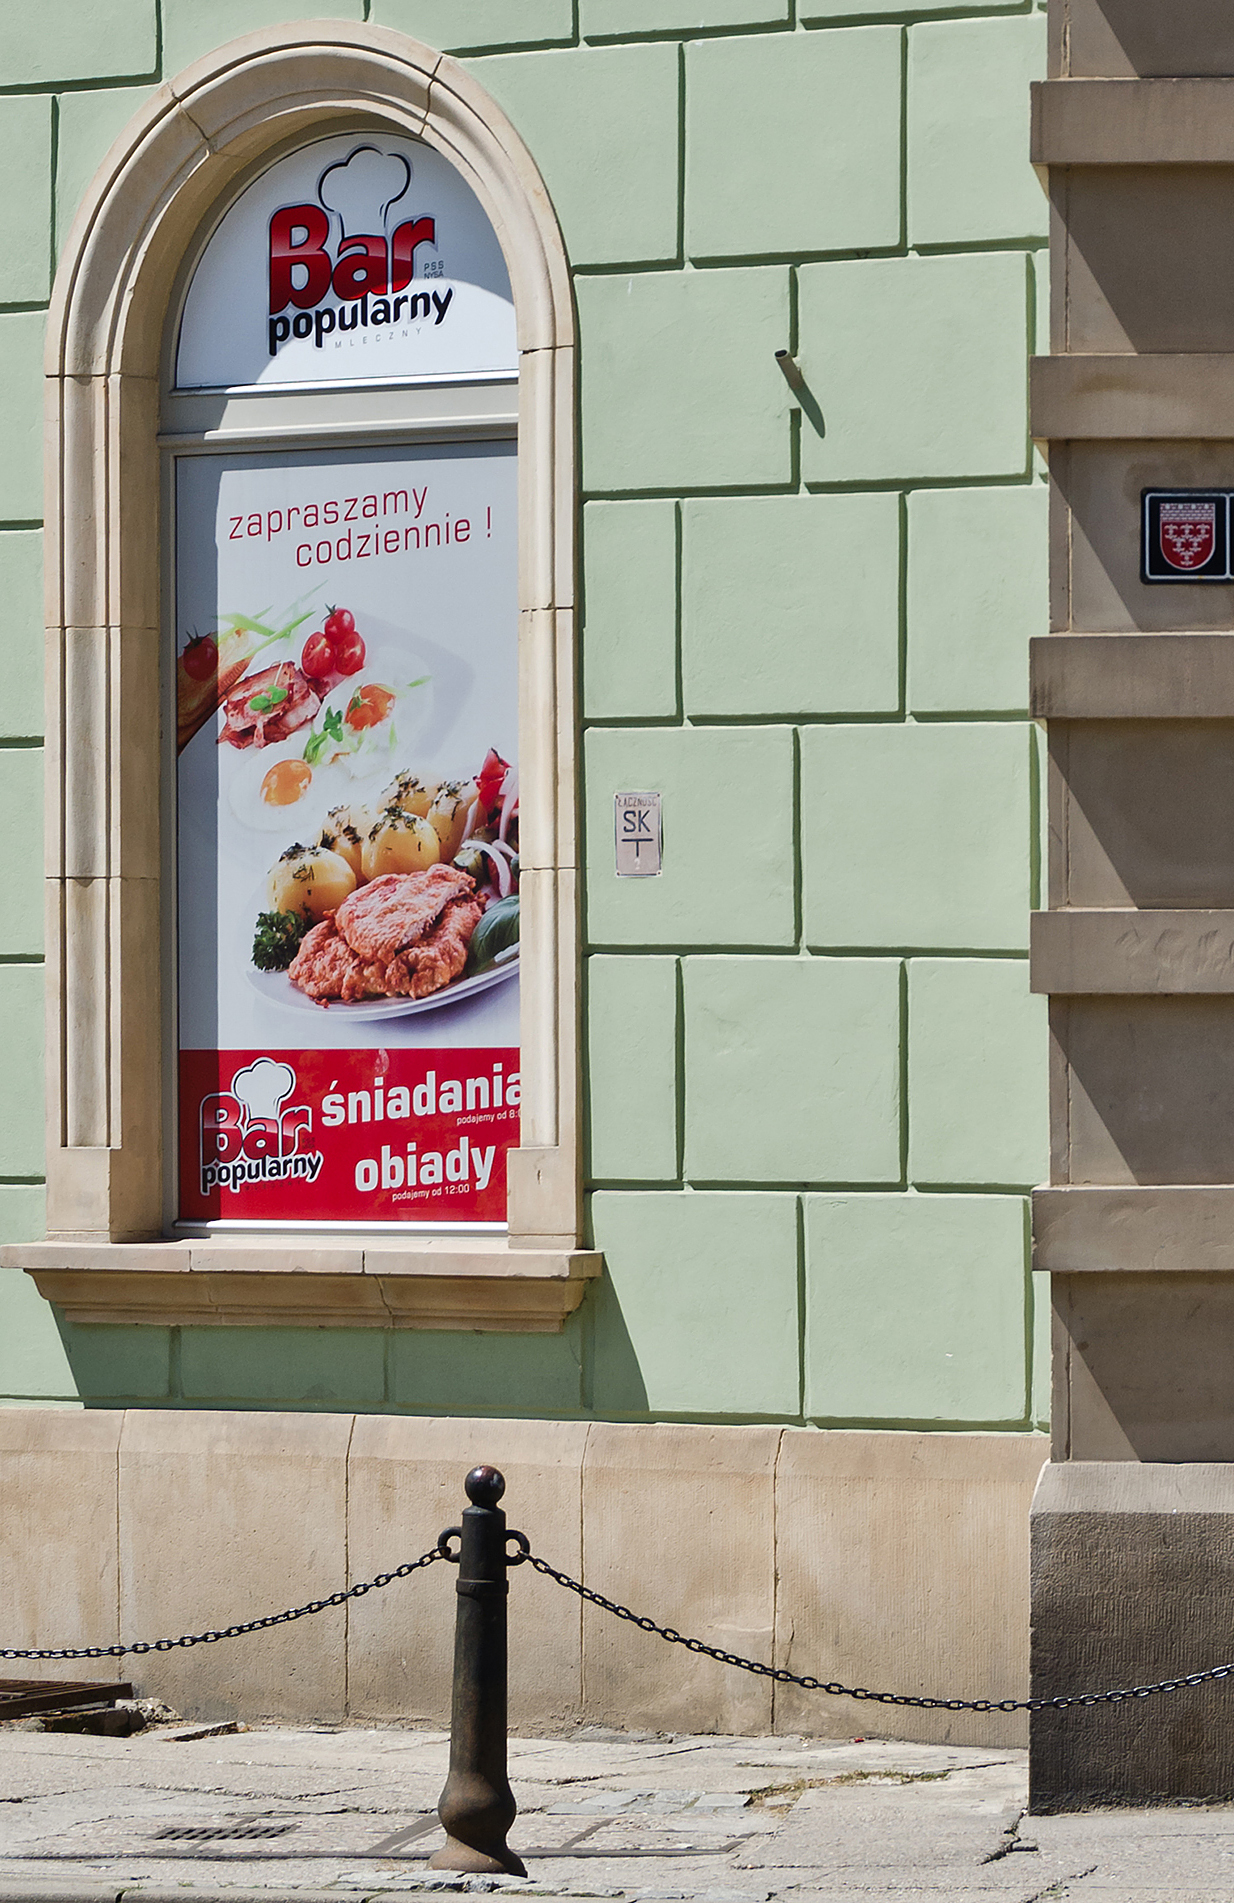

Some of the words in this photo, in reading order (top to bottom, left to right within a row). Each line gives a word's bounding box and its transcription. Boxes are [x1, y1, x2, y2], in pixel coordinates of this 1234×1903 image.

[268, 202, 436, 315] Bar
[423, 260, 445, 272] PSS
[423, 270, 445, 280] NYSA
[268, 287, 454, 356] popularny
[228, 485, 429, 542] zapraszamy
[296, 512, 472, 568] codziennie
[623, 809, 651, 833] SK
[321, 1062, 521, 1127] śniadania
[456, 1113, 496, 1127] podajemy
[496, 1110, 507, 1121] od
[200, 1093, 312, 1165] Bar
[201, 1156, 322, 1194] popularny
[354, 1136, 496, 1192] obiady
[392, 1189, 430, 1202] podajemy
[431, 1186, 442, 1196] od
[444, 1183, 470, 1195] 12:00
